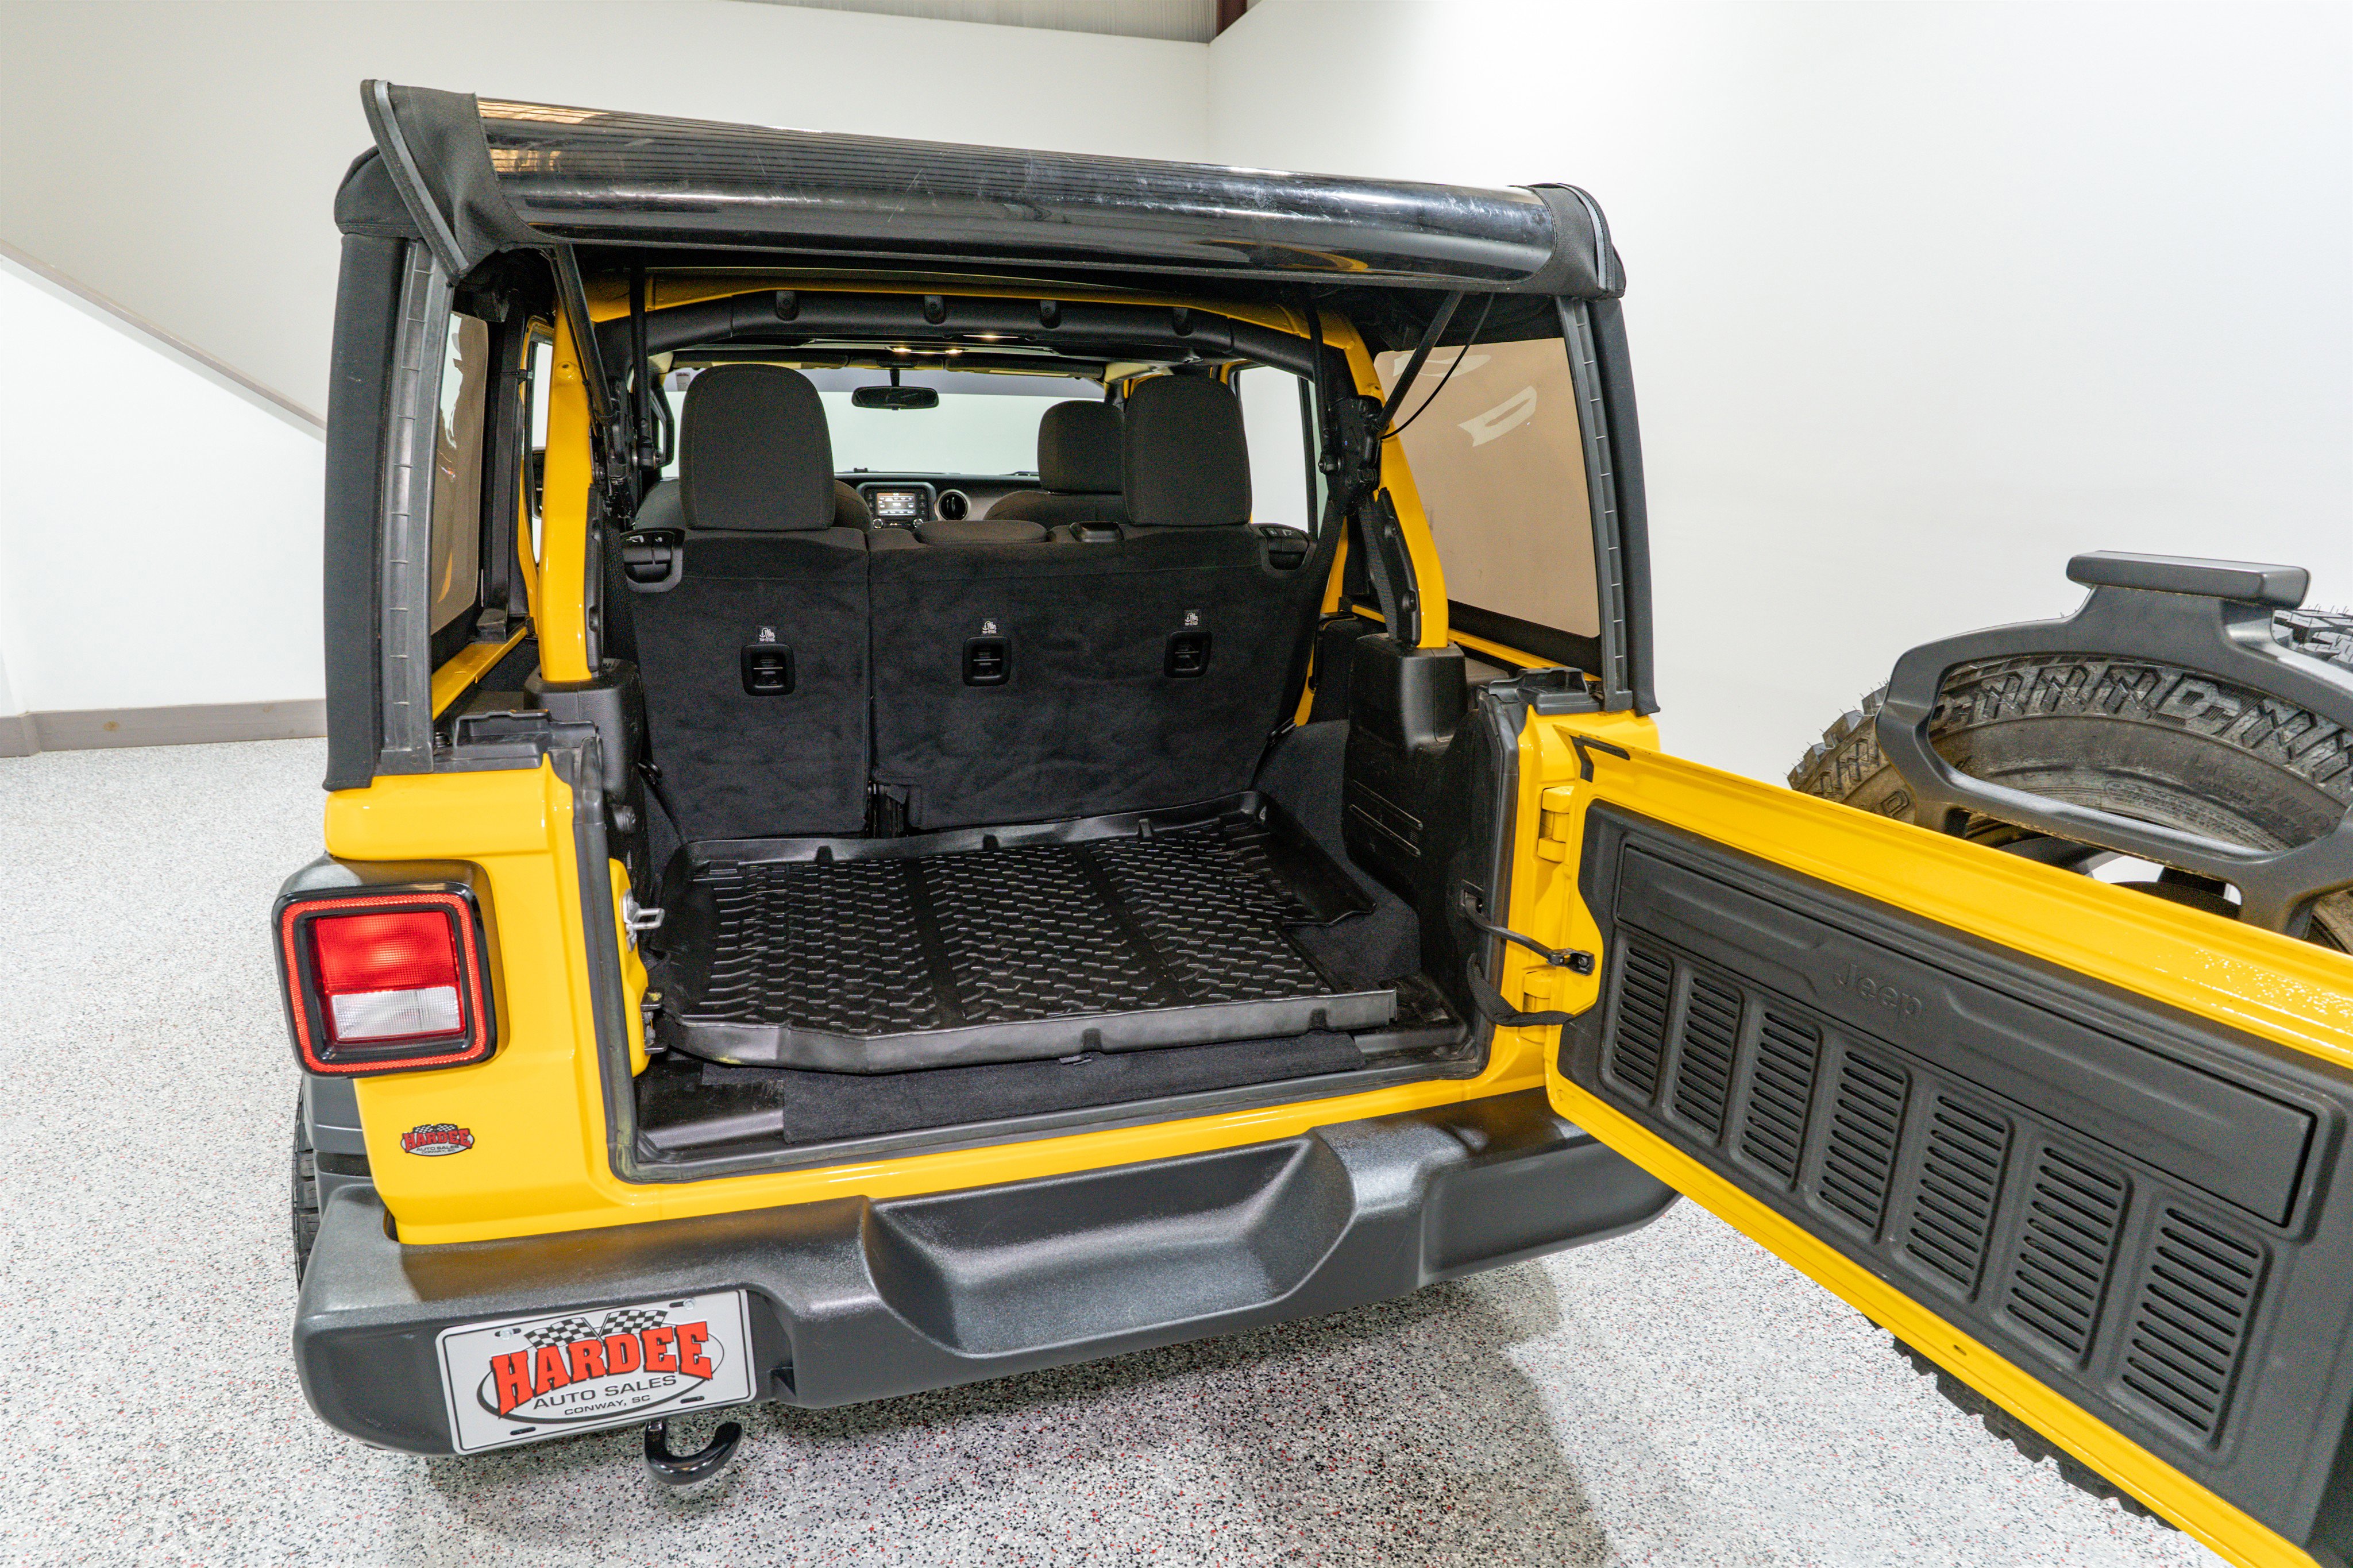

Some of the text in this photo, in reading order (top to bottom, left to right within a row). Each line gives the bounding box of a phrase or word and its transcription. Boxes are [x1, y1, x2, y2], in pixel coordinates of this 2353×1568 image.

[1832, 963, 1922, 1024] Jeep
[403, 1127, 472, 1152] HARDEE
[490, 1321, 713, 1418] HARDEE
[533, 1375, 677, 1411] AUTO SALES
[564, 1395, 651, 1416] CONWAY, SC
